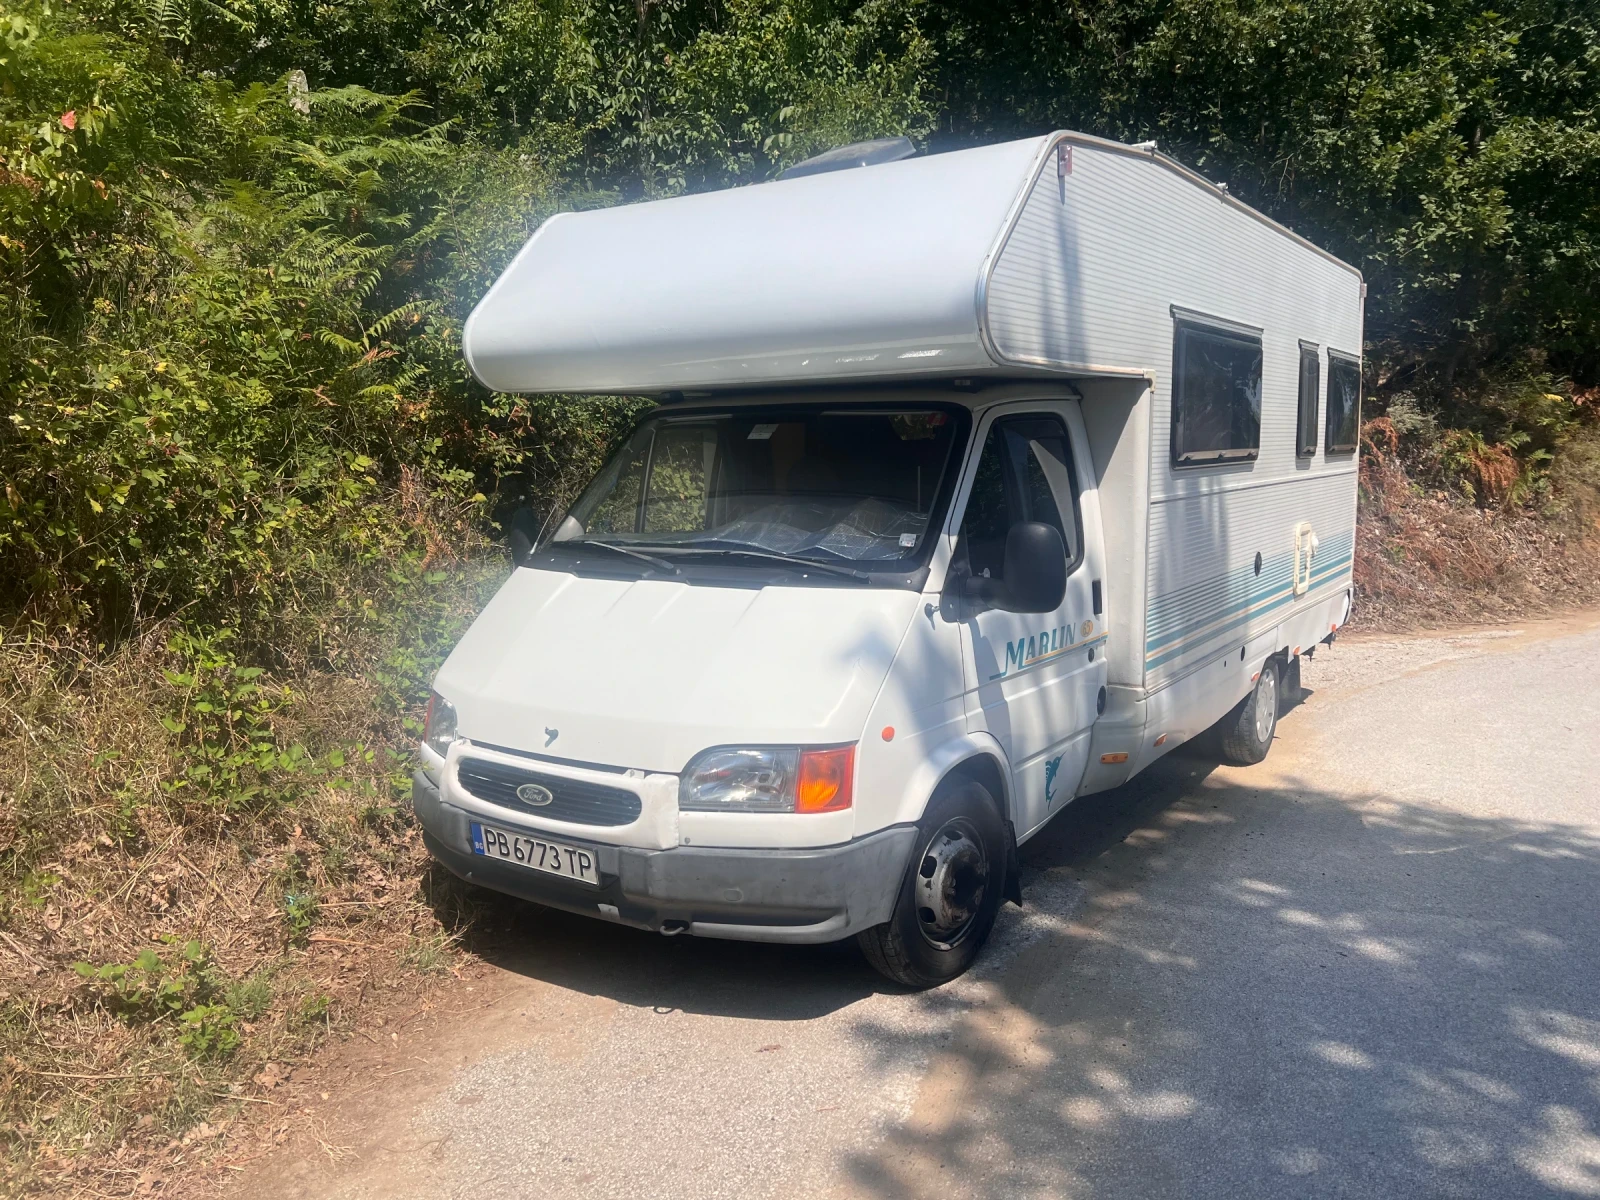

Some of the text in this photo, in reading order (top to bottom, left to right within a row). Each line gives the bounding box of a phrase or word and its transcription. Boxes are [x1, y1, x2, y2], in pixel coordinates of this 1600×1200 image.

[989, 622, 1076, 680] MARLIN
[523, 787, 544, 802] Ford
[474, 841, 485, 850] BG
[483, 828, 592, 877] PB 6773 TP
